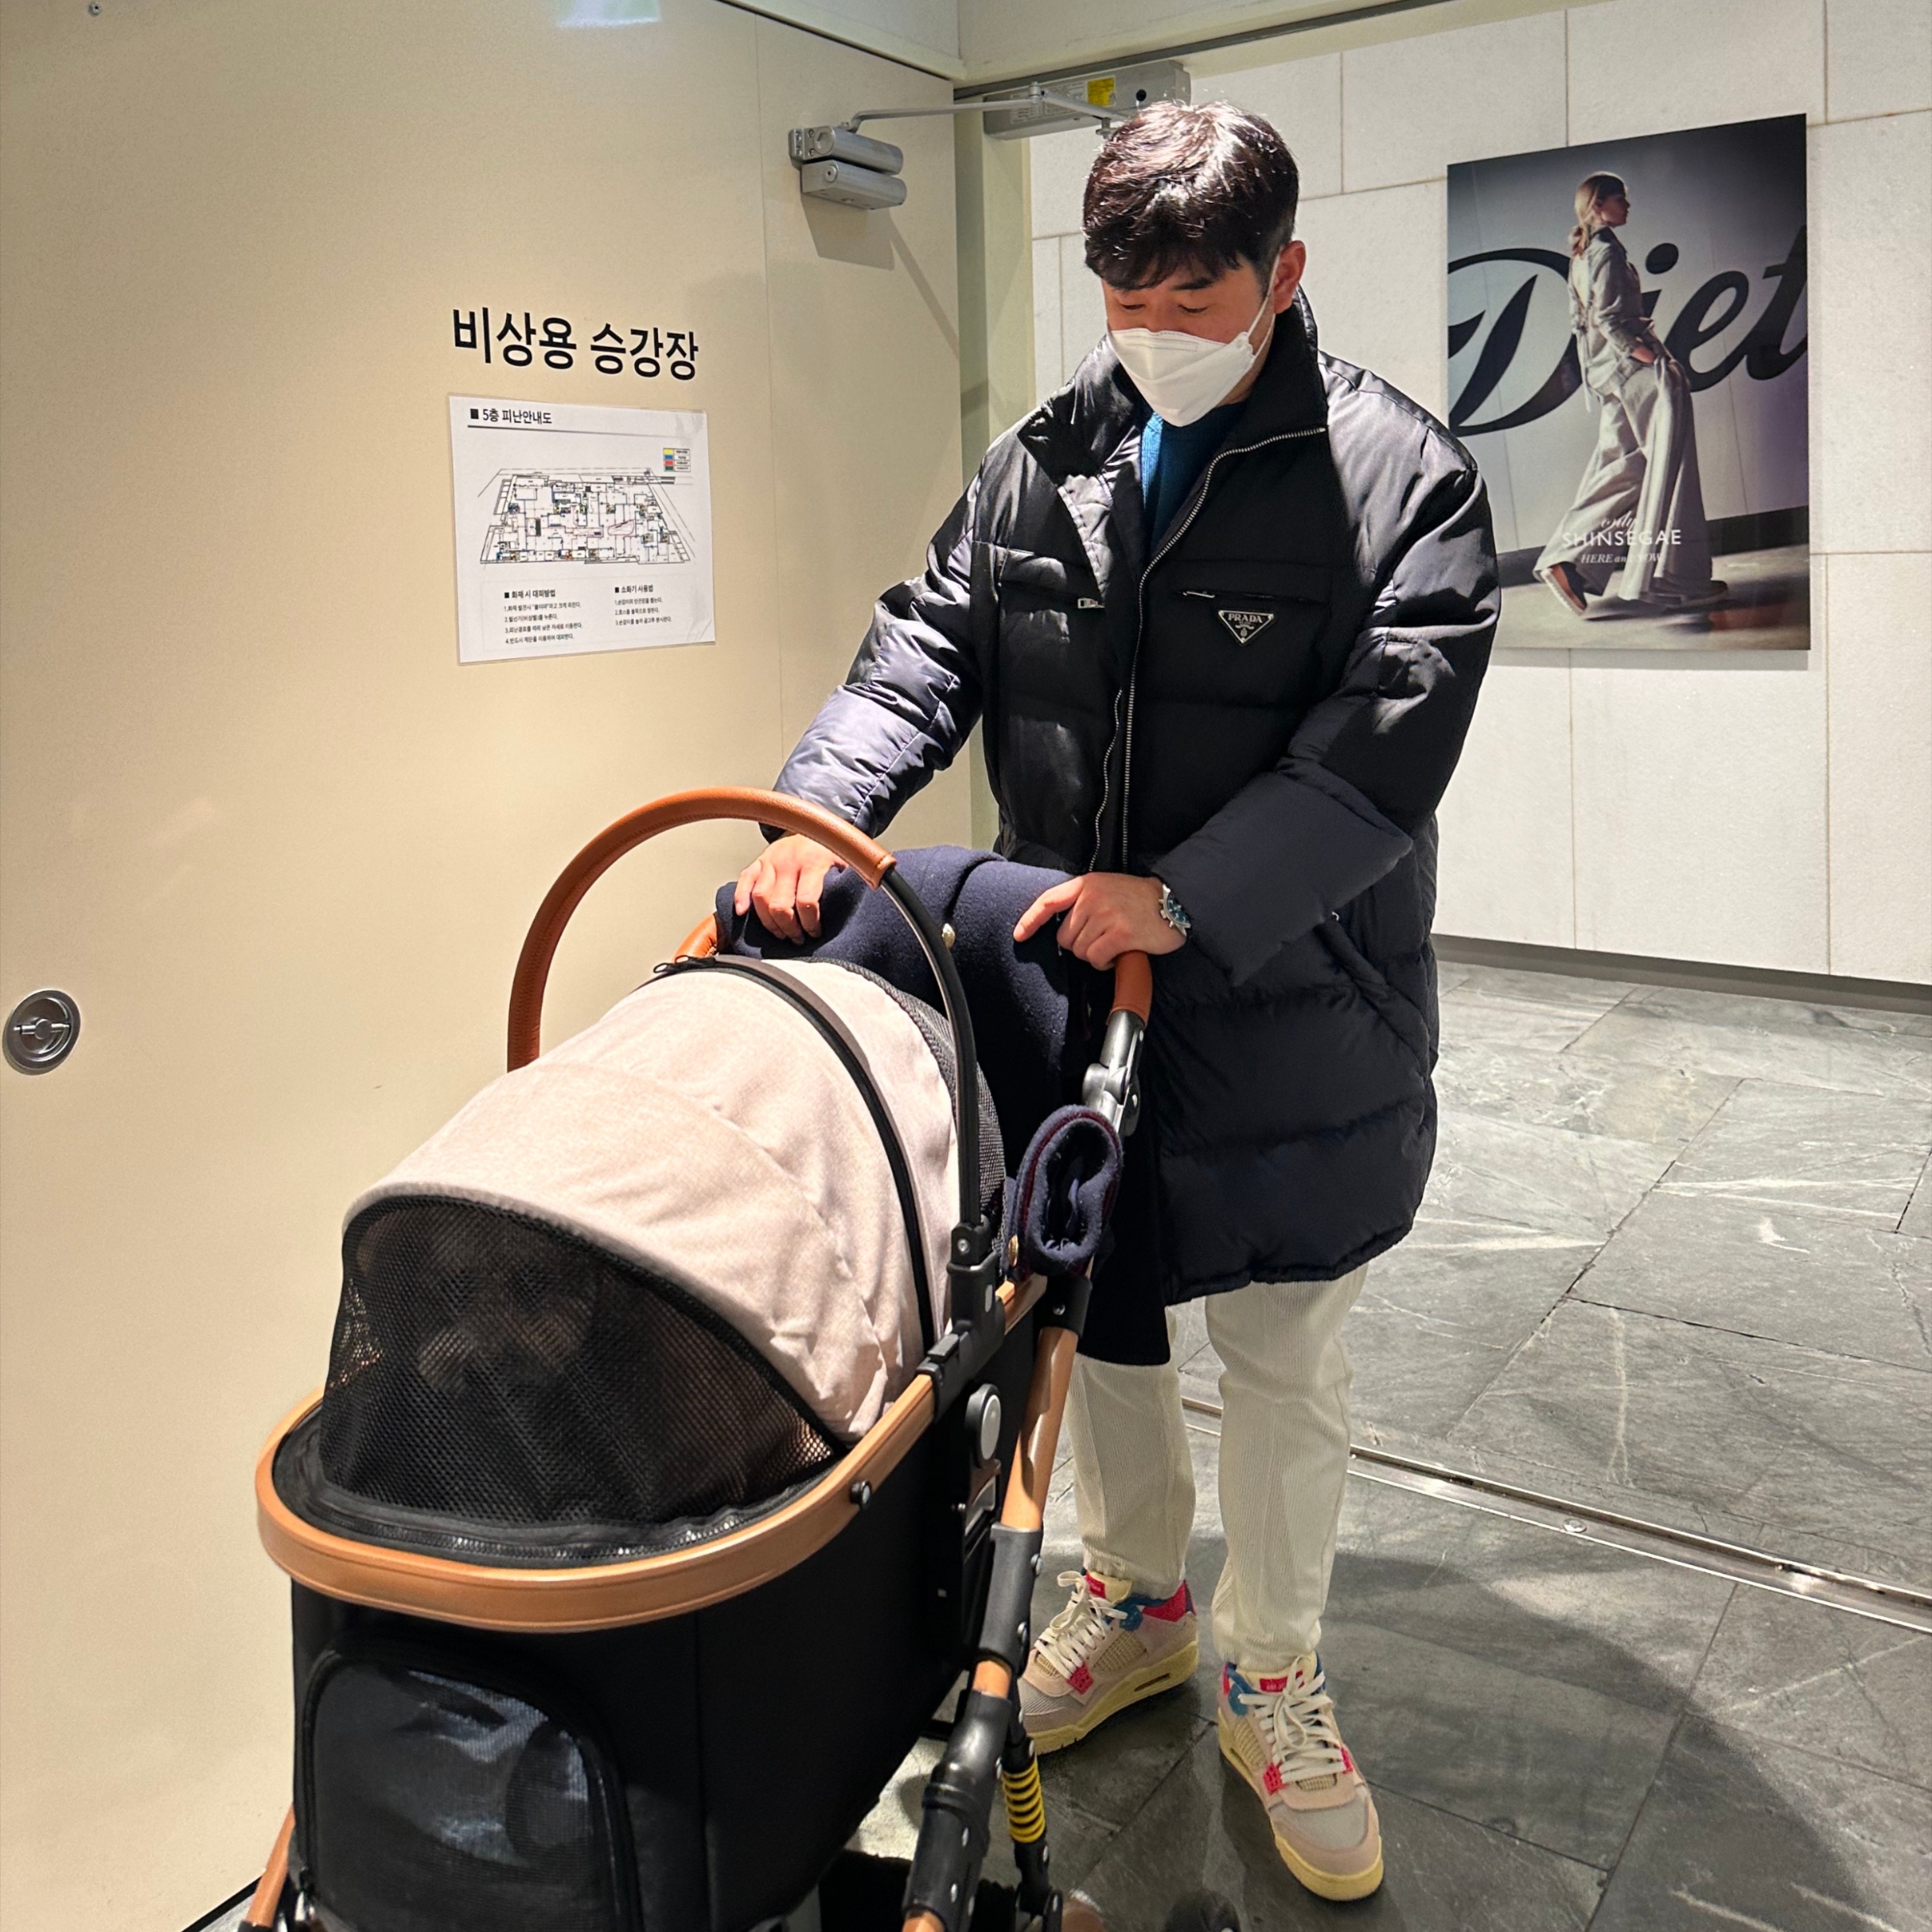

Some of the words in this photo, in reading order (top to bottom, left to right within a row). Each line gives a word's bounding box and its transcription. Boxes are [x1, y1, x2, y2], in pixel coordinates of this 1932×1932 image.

[453, 306, 577, 370] 비상용
[590, 323, 699, 380] 승강장
[483, 408, 499, 422] 5층
[501, 408, 552, 425] 피난안내도
[1562, 530, 1682, 547] SHINSEGAE
[1580, 553, 1613, 564] HERE
[525, 590, 531, 598] 시
[1228, 613, 1263, 623] PRADA
